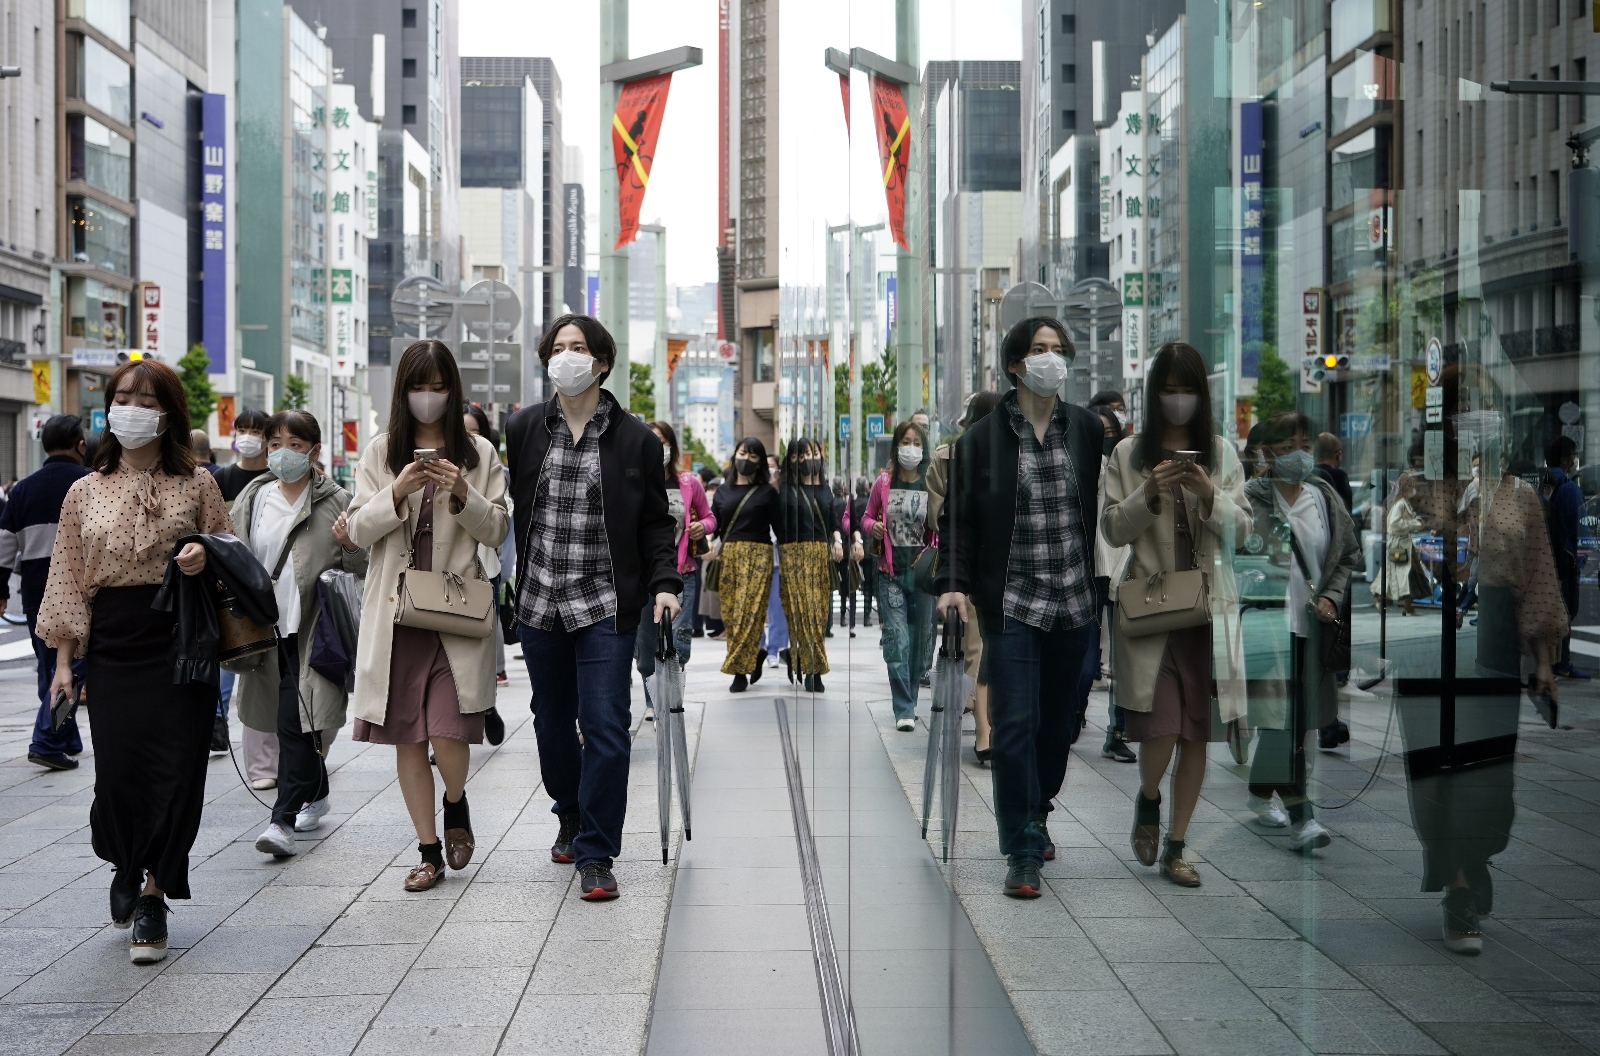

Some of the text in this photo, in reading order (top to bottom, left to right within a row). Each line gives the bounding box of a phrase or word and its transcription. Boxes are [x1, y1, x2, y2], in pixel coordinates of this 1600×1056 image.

[205, 145, 223, 250] 山野楽器
[332, 106, 350, 213] 教文館
[332, 273, 350, 299] 本
